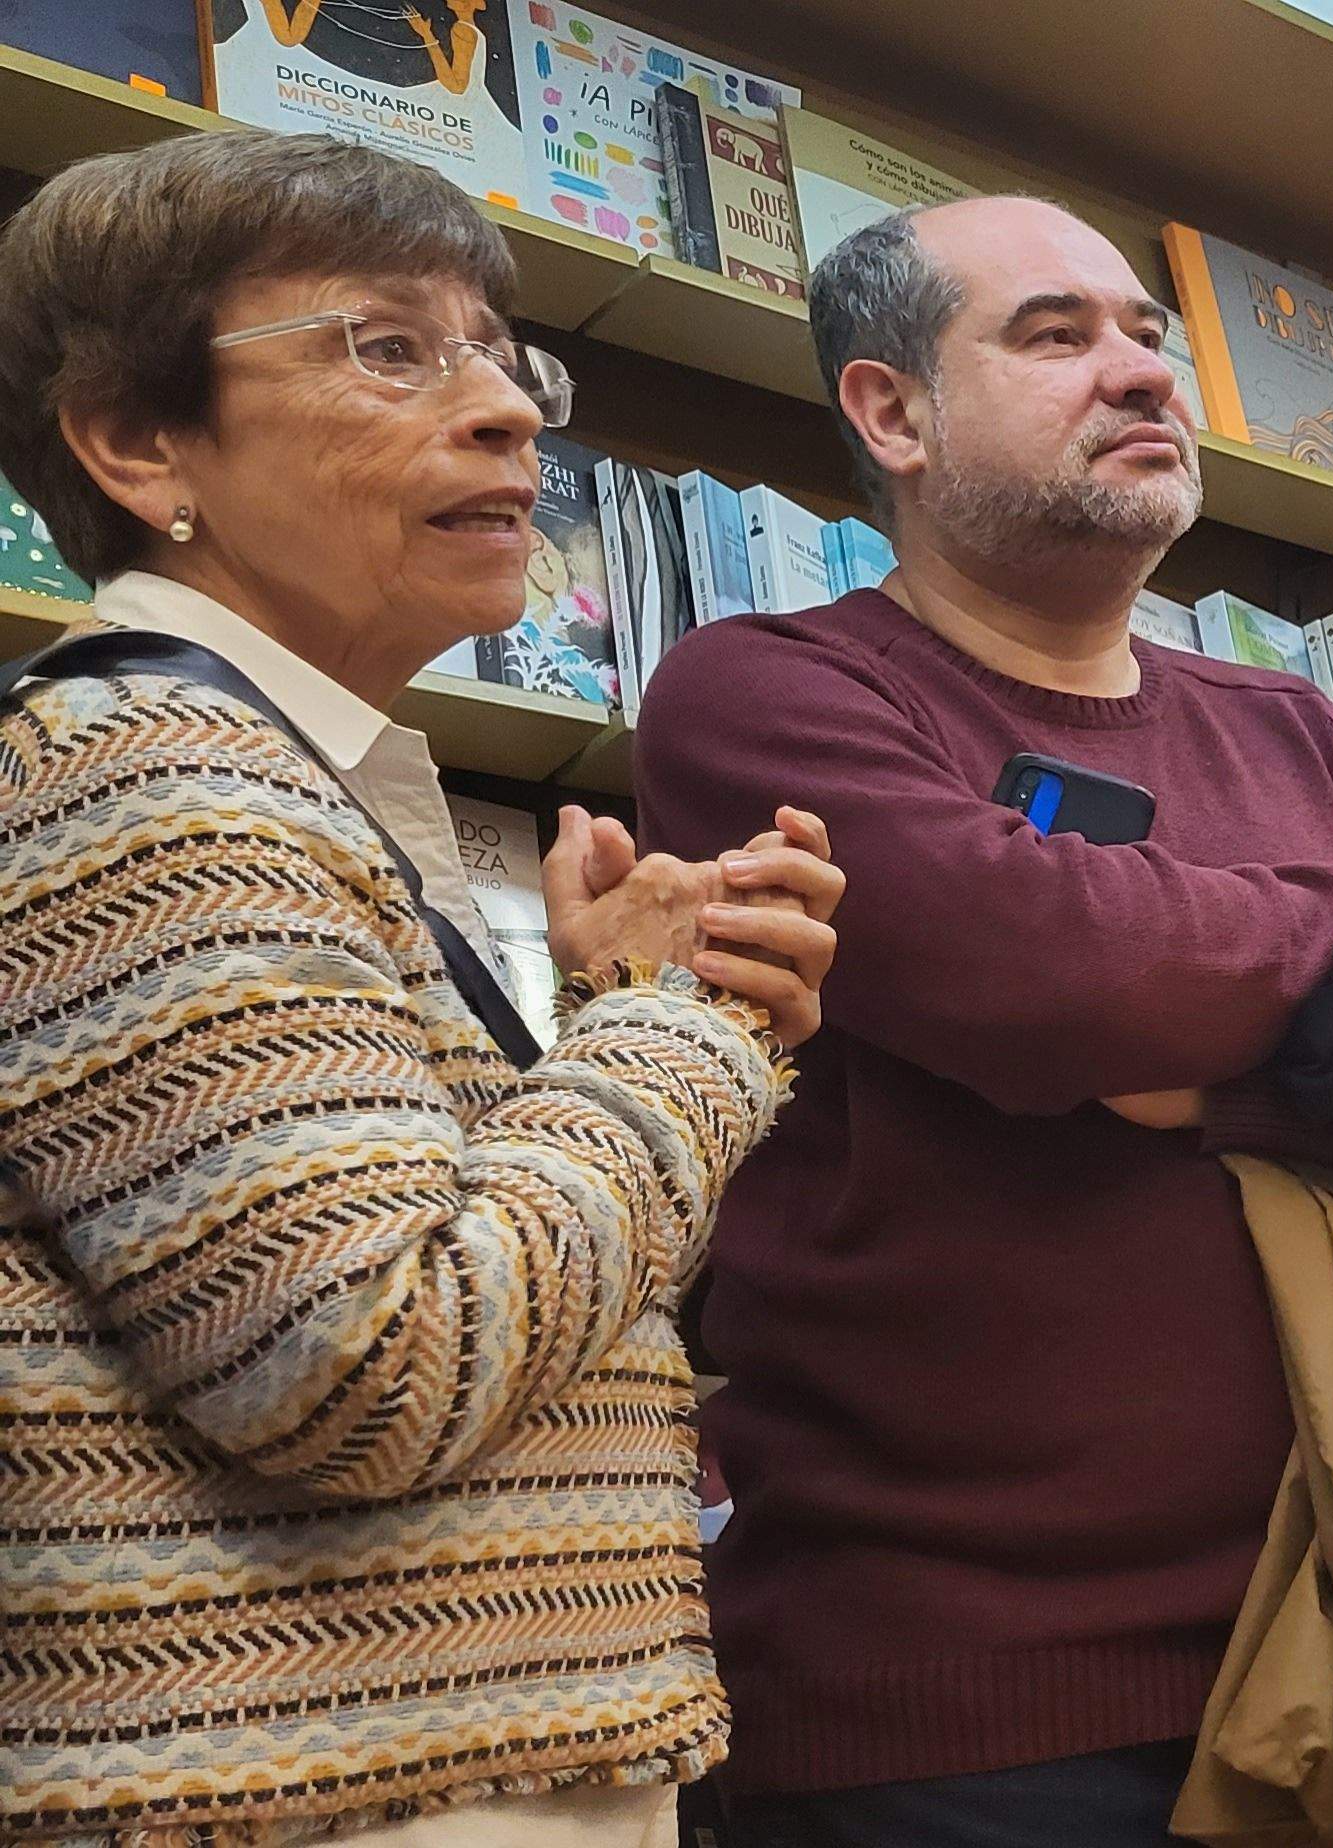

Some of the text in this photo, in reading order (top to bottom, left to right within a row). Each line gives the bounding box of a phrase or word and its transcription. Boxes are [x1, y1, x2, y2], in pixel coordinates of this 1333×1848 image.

[276, 65, 473, 134] DICCIONARIO DE
[278, 83, 354, 117] MITOS
[595, 114, 619, 129] CON
[849, 139, 884, 162] Cómo
[887, 158, 907, 173] son
[910, 166, 926, 181] los
[750, 187, 791, 224] QUÉ
[456, 819, 501, 847] DO
[459, 844, 509, 876] EZA
[467, 874, 502, 890] BUJO
